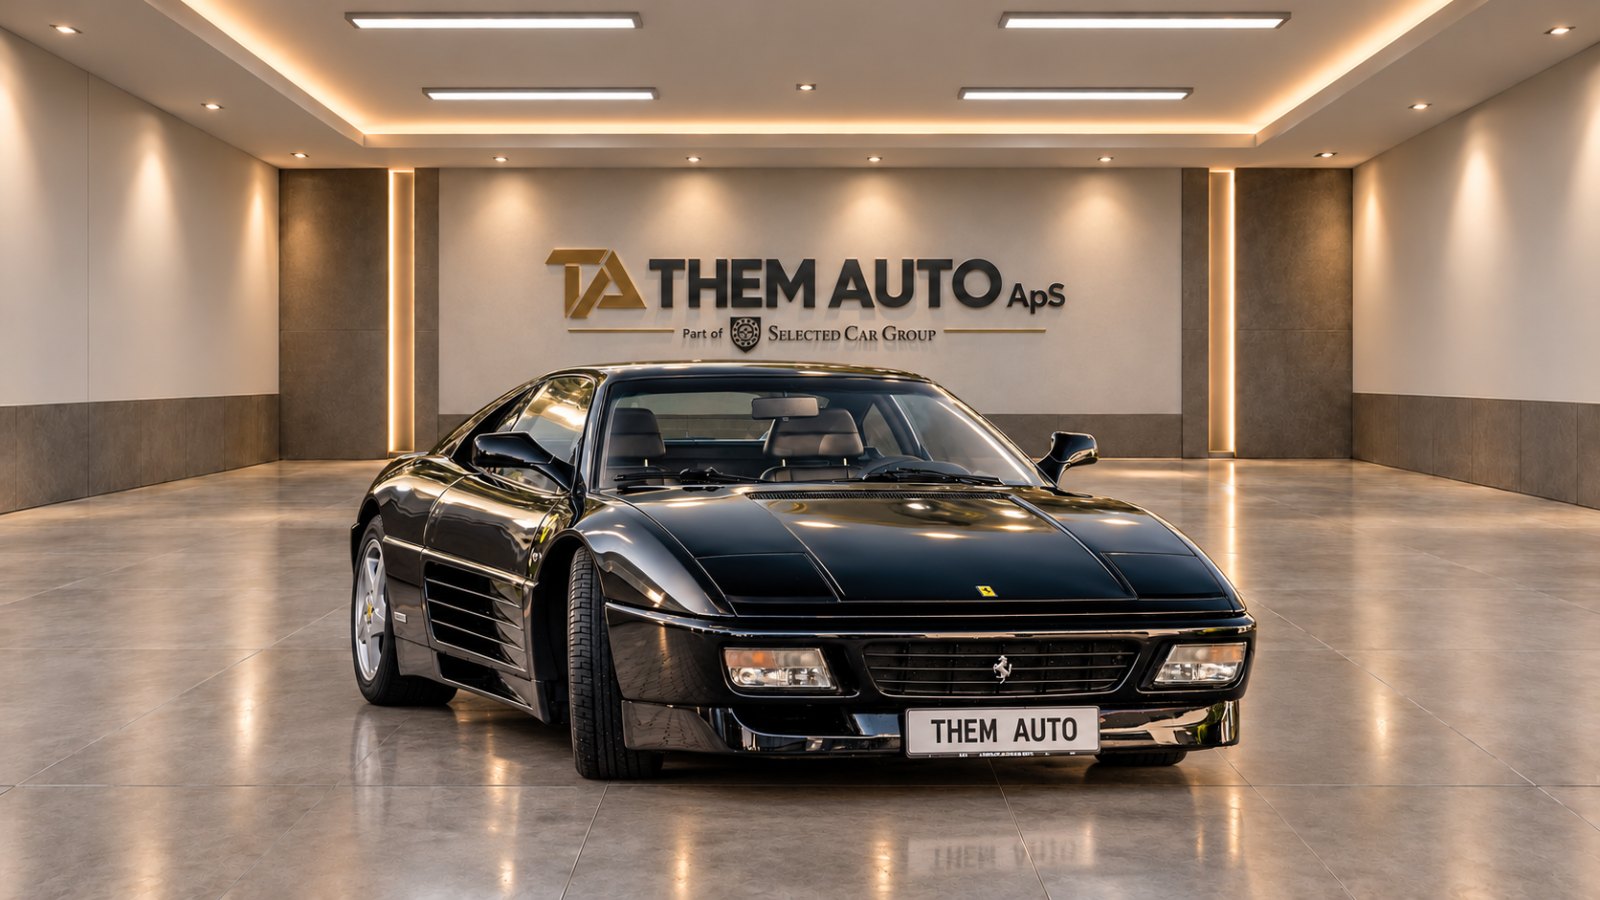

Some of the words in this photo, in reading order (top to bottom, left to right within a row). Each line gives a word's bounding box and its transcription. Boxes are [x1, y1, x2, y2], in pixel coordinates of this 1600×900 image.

[649, 259, 816, 308] THEM
[828, 258, 1003, 309] AUTO
[1007, 282, 1066, 315] ApS
[683, 328, 707, 339] Part
[711, 327, 723, 339] of
[931, 718, 998, 744] THEM
[1013, 717, 1078, 742] AUTO
